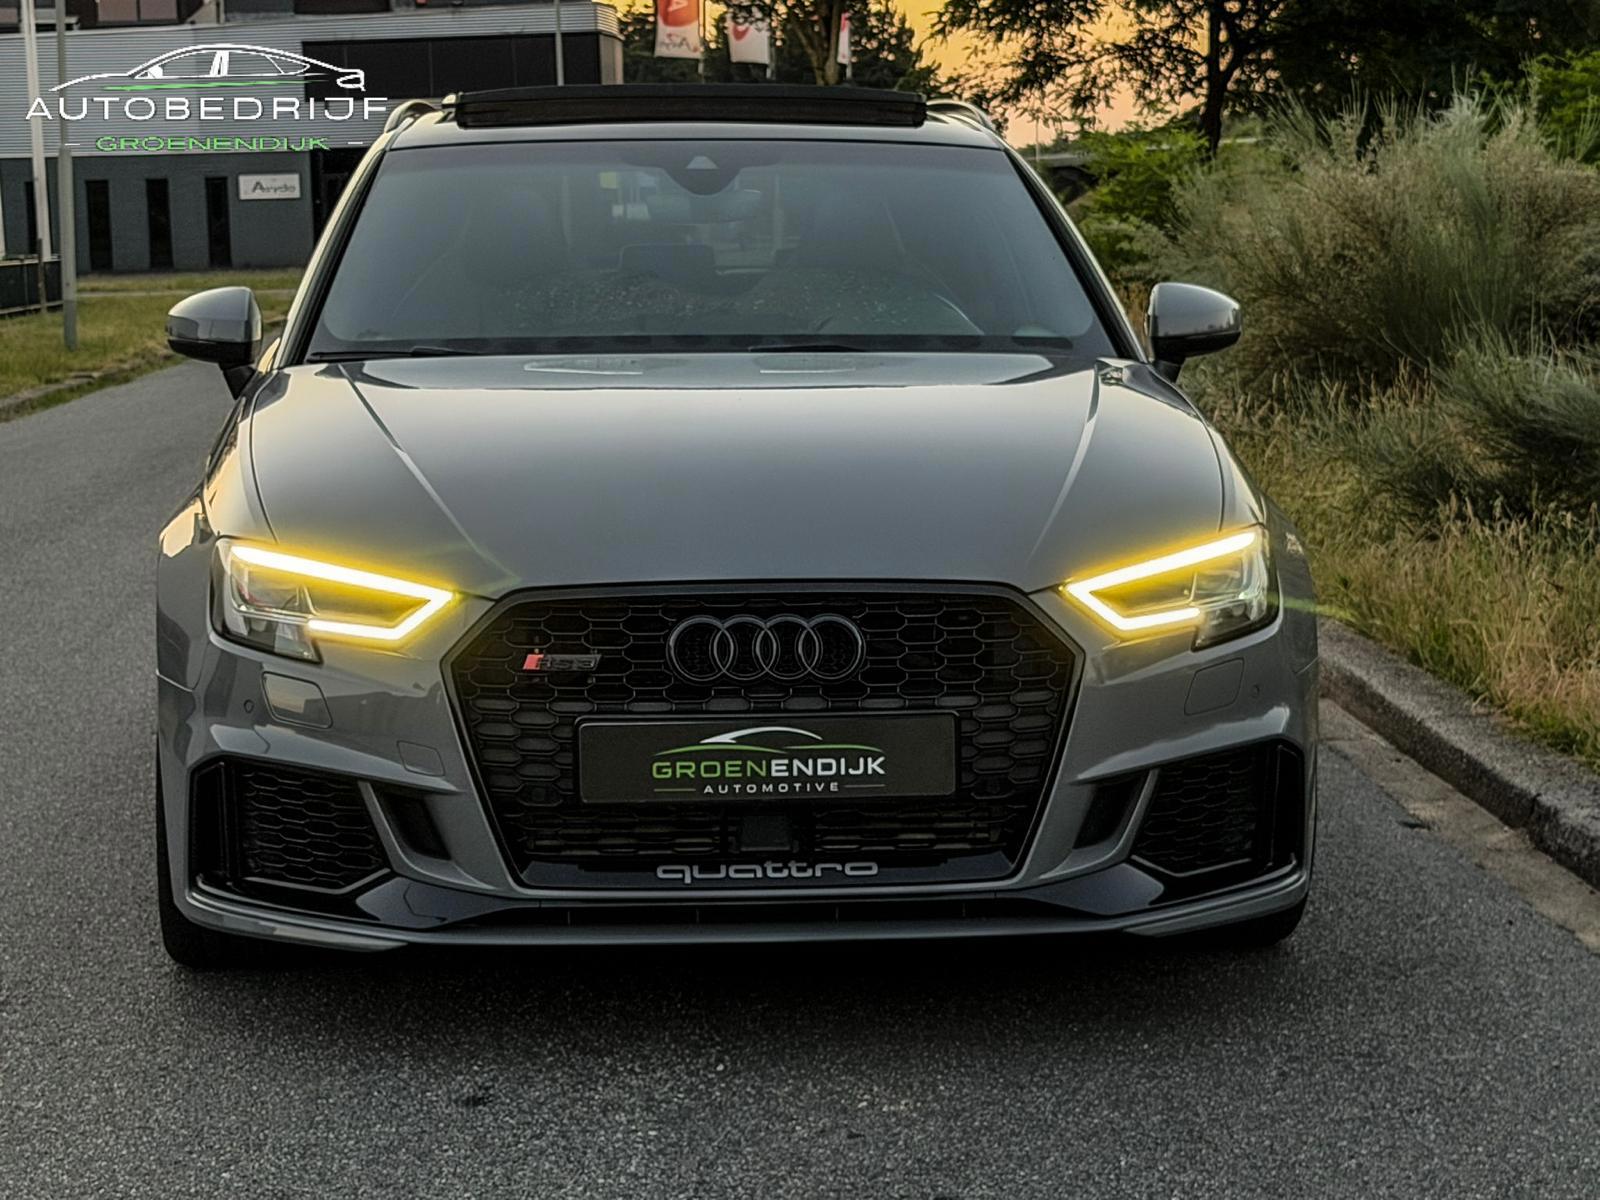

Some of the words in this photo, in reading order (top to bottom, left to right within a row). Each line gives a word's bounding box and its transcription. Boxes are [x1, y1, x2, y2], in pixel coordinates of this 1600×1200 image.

[652, 757, 886, 779] GROENENDIJK
[703, 782, 839, 794] AUTOMOTIVE
[656, 860, 879, 884] quattro
